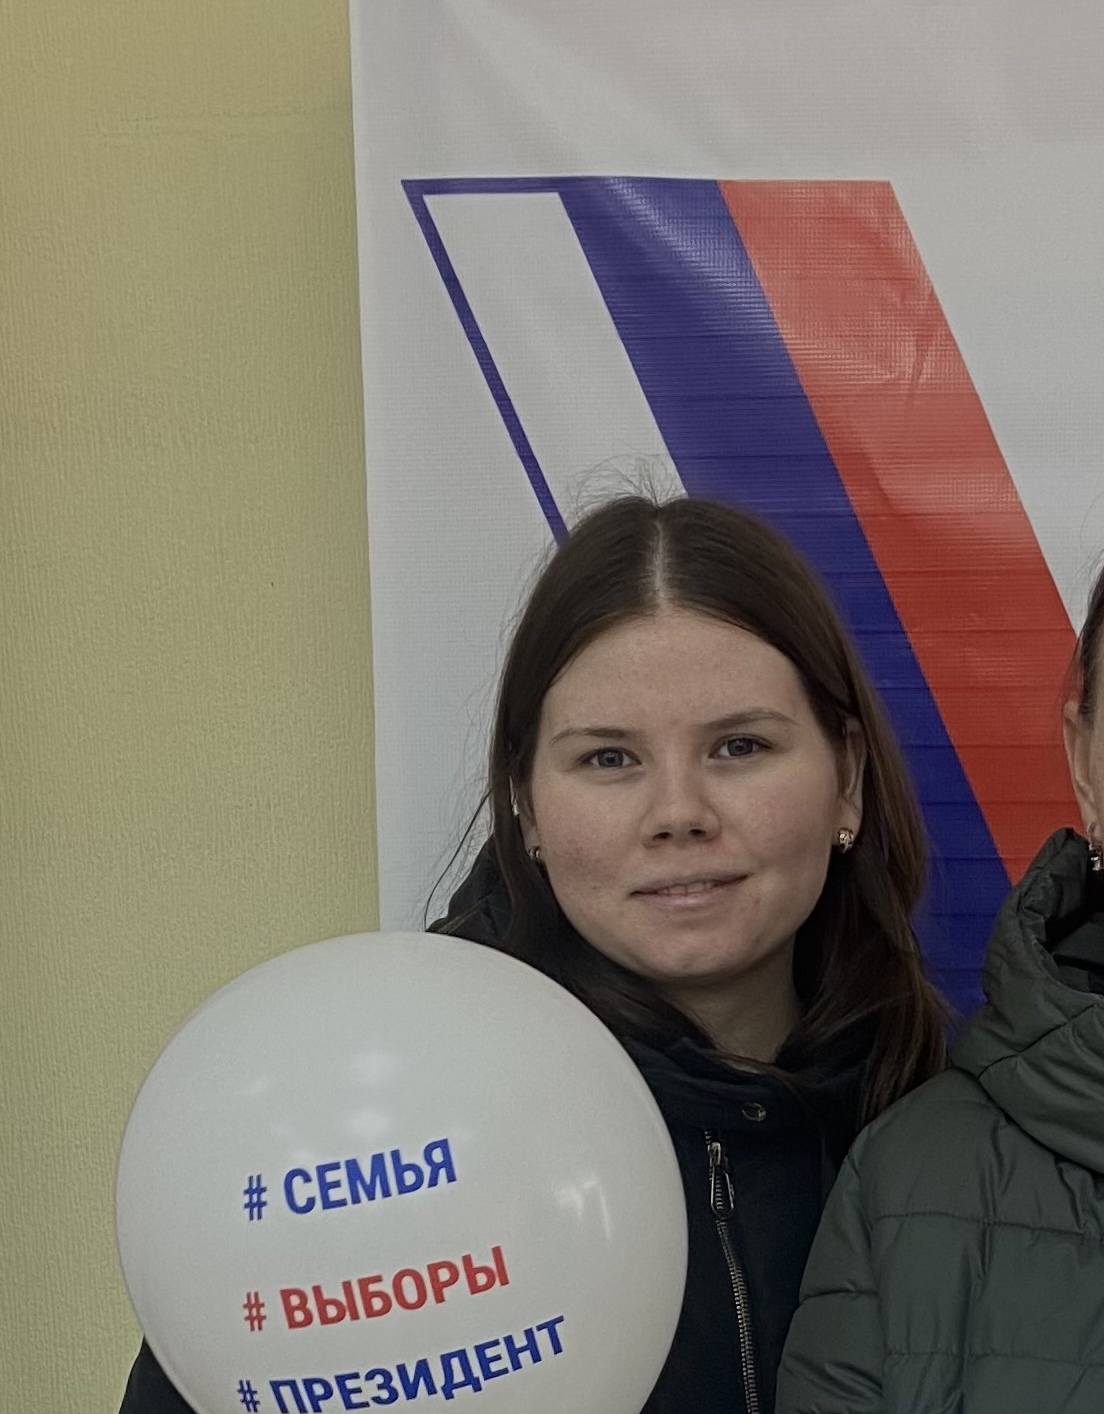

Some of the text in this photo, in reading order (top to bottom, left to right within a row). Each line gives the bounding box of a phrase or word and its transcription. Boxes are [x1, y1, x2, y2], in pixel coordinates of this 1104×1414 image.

[243, 1138, 458, 1221] # СЕМЬЯ
[243, 1245, 510, 1332] # ВЫБОРЫ
[237, 1315, 565, 1414] # ПРЕЗИДЕНТ
